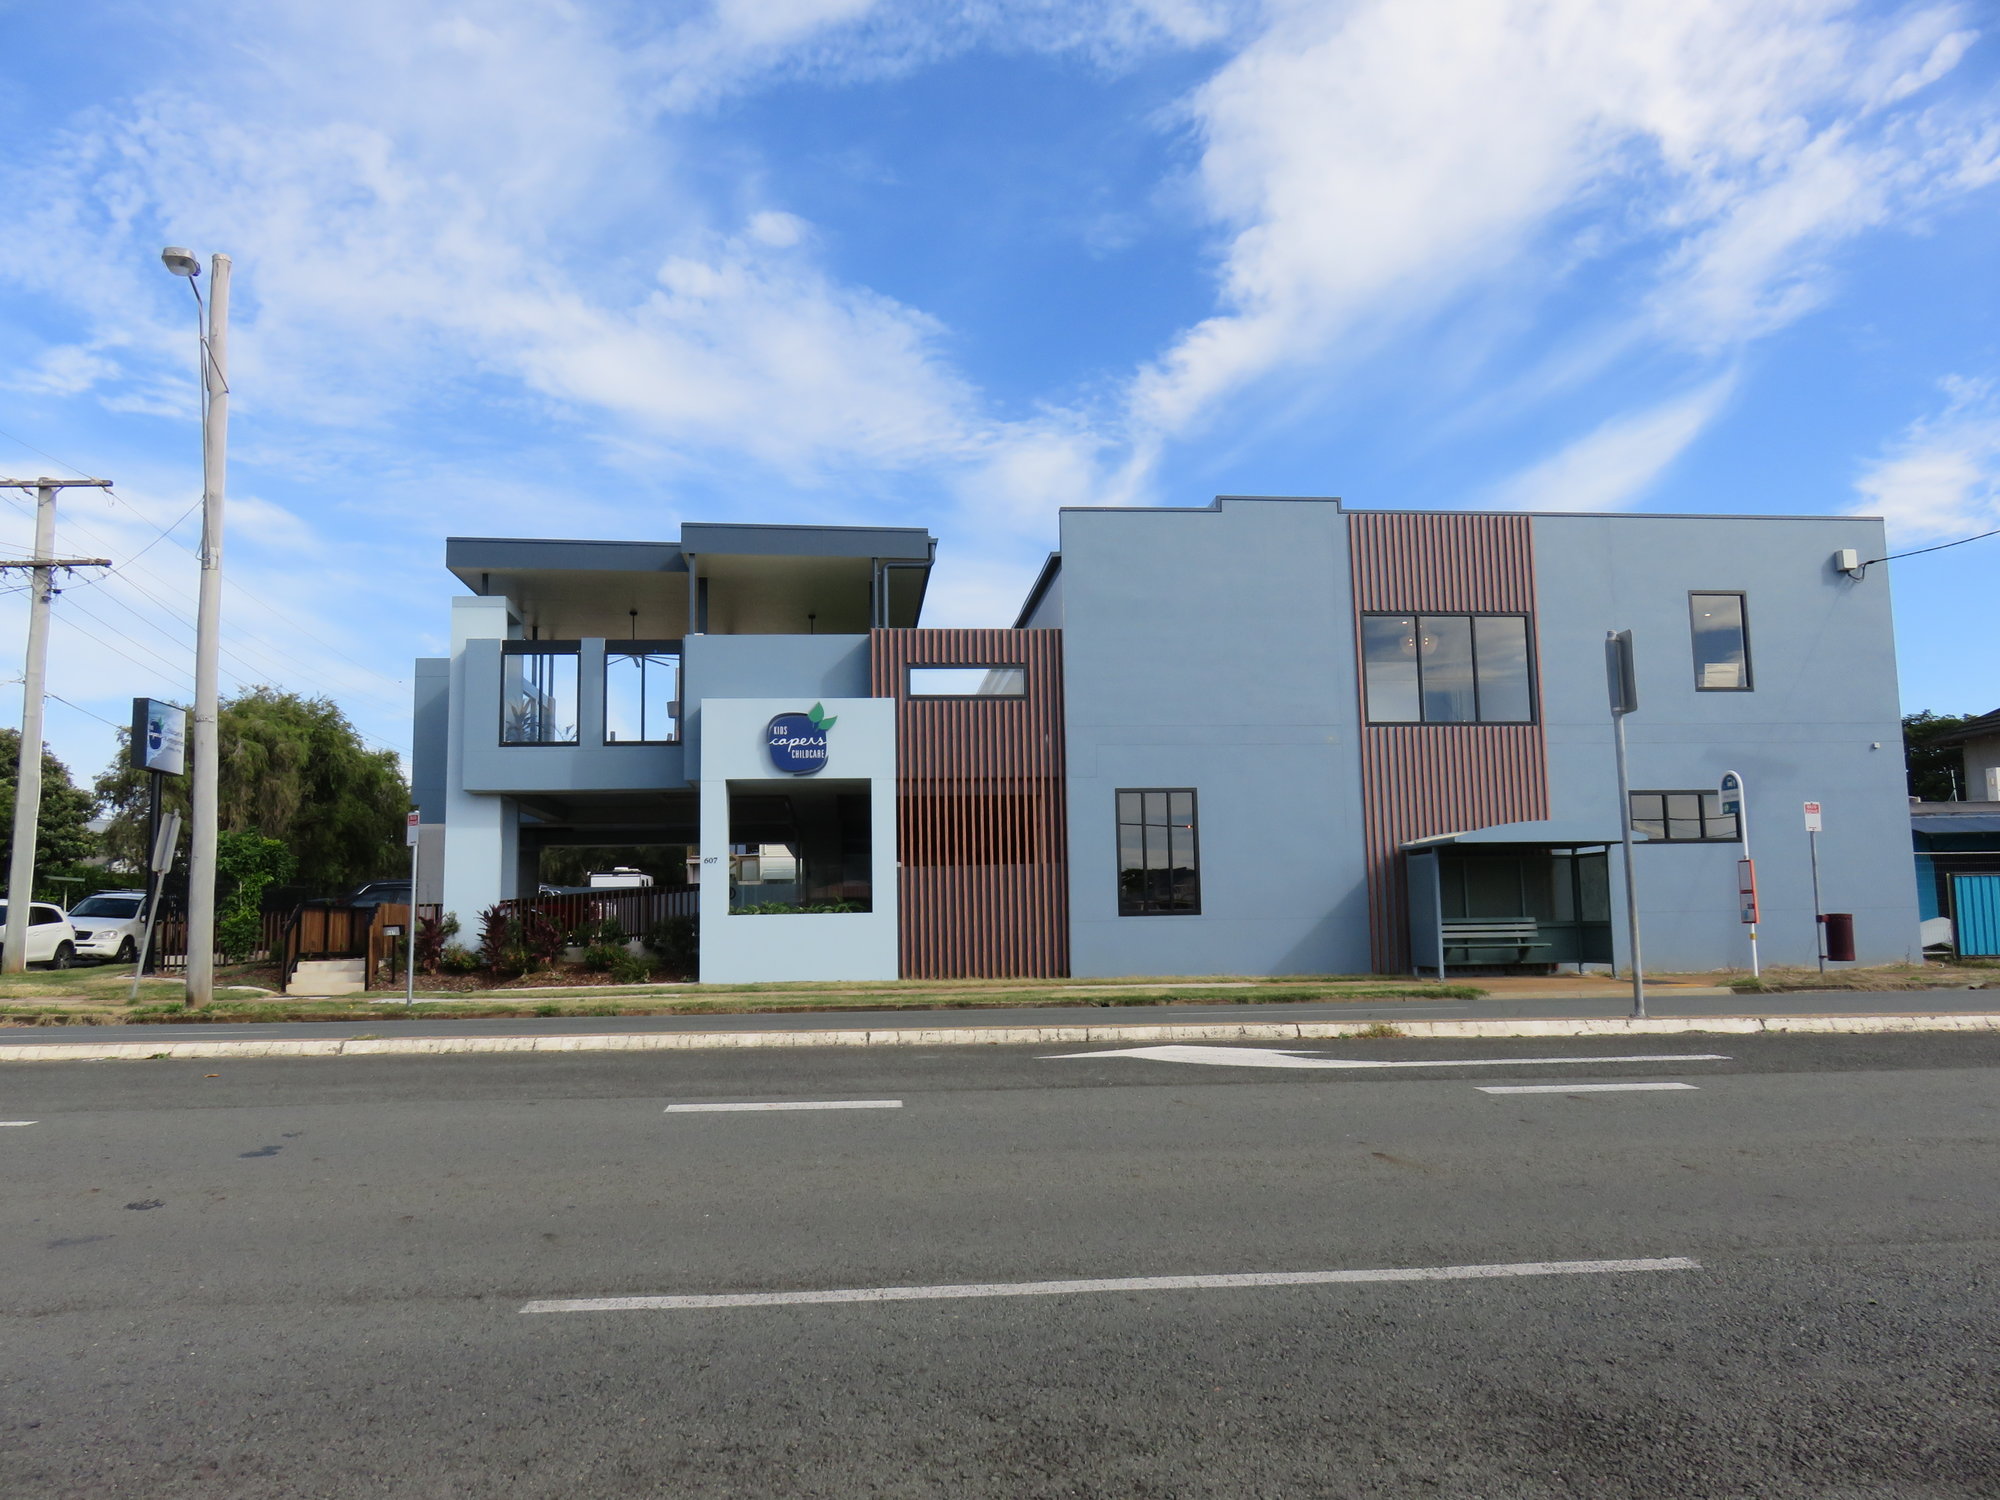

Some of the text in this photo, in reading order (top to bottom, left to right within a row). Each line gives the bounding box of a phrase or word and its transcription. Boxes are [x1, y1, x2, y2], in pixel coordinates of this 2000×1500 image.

[773, 726, 788, 735] KIDS
[769, 736, 828, 753] capers
[791, 749, 825, 759] CHILDCARE
[703, 856, 718, 864] 607
